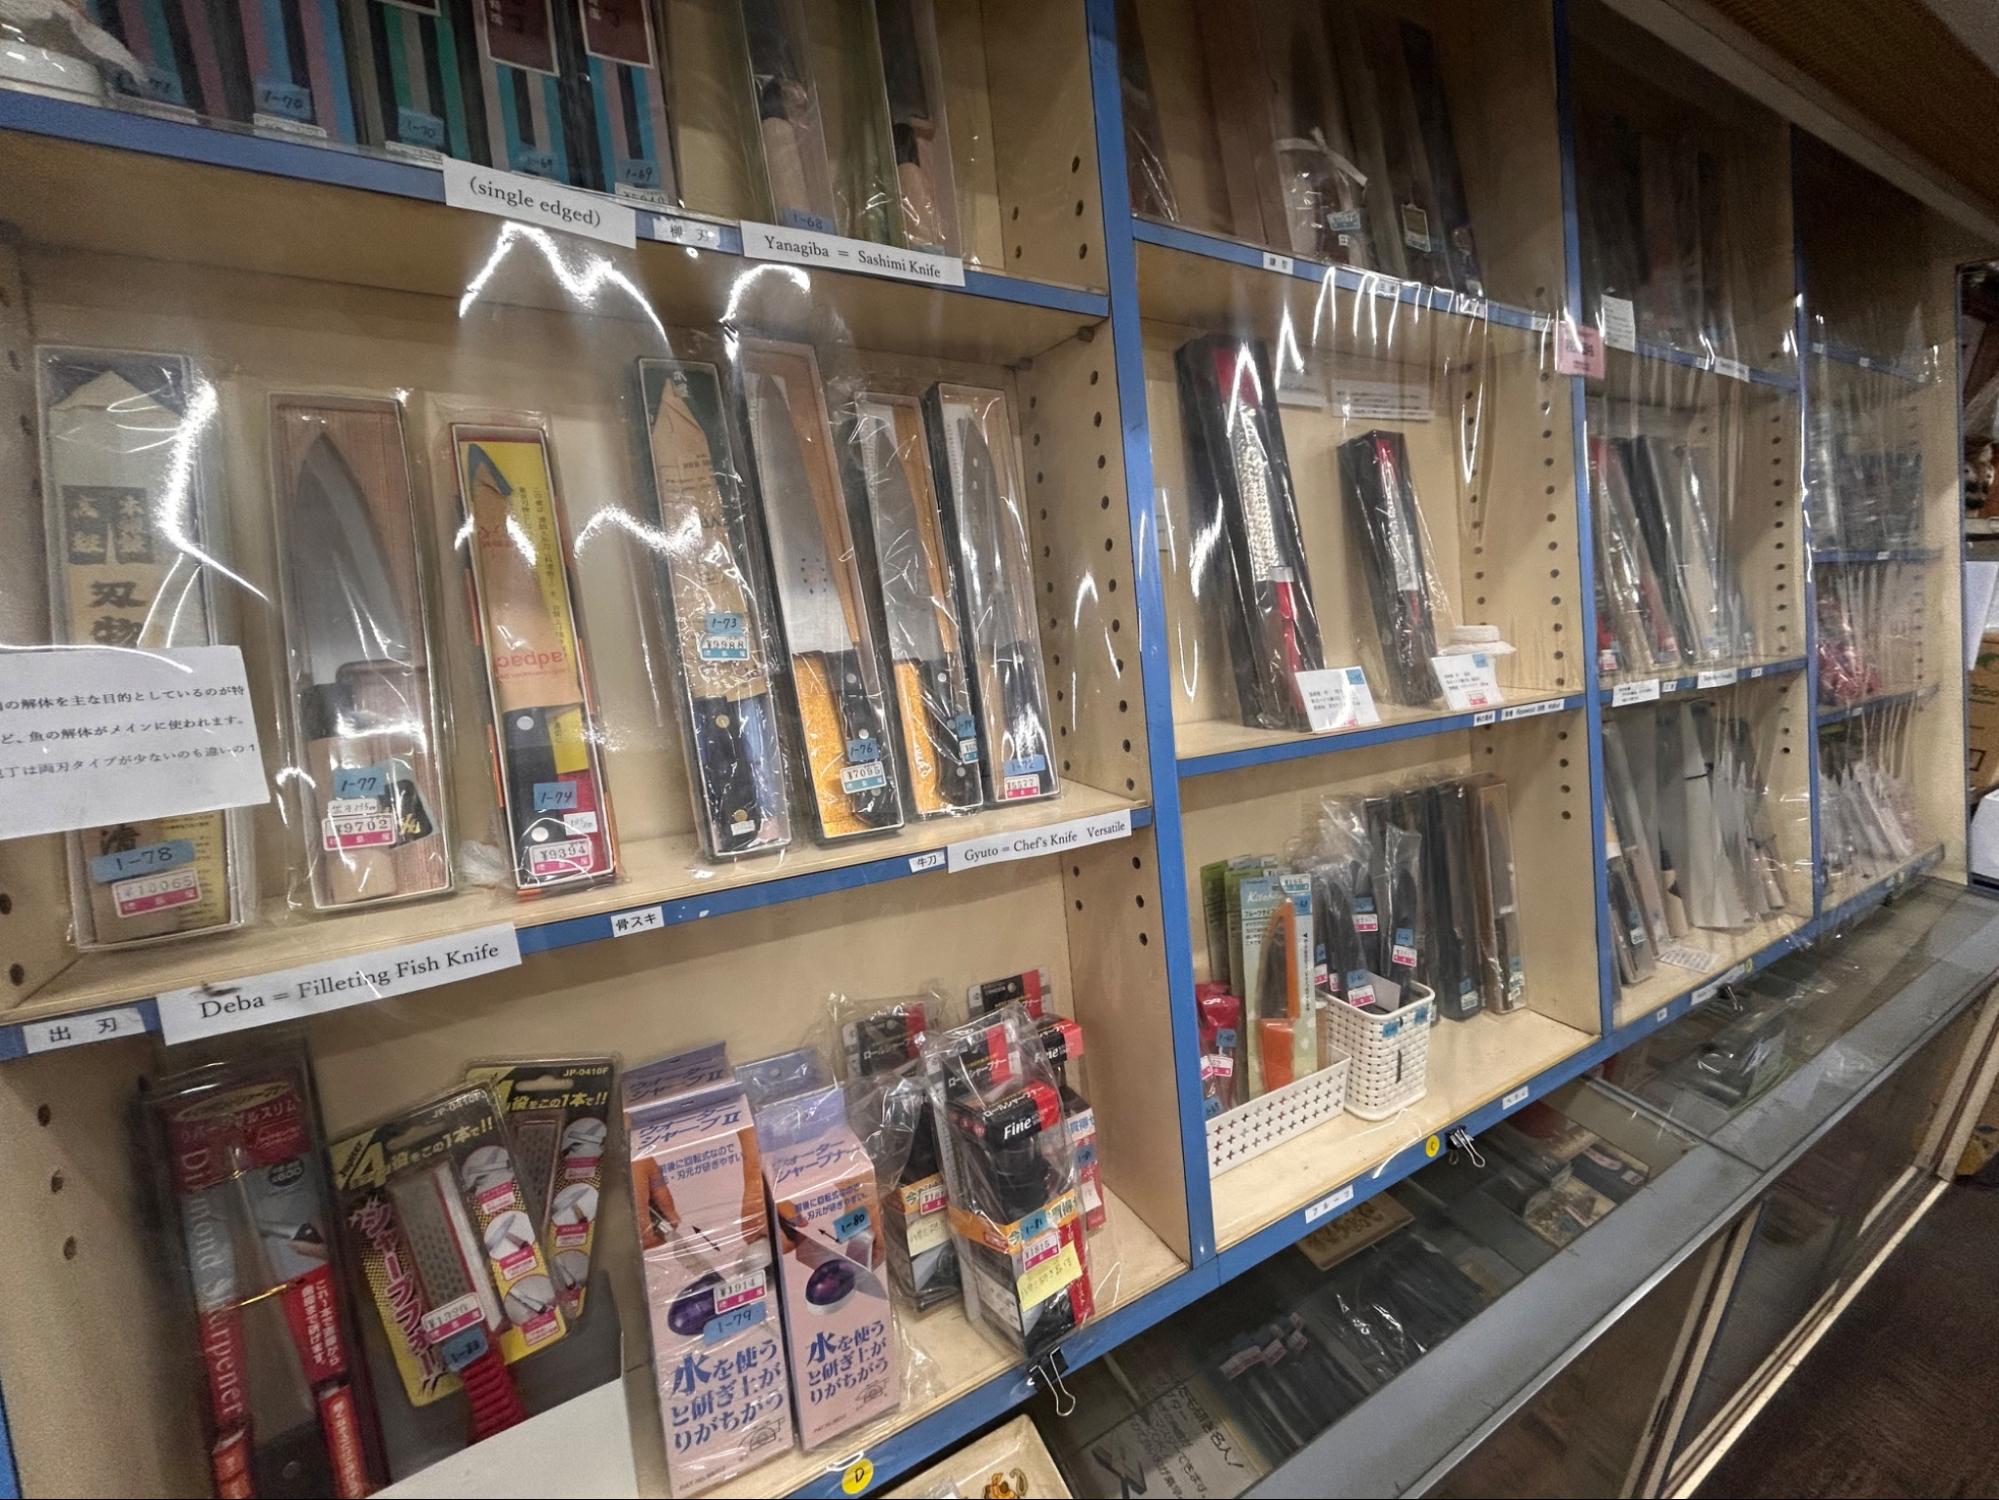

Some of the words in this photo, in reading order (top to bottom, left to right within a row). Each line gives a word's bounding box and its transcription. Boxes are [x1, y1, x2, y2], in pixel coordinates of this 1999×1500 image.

[625, 165, 654, 181] 1-69
[470, 175, 534, 208] (single
[540, 199, 601, 228] edged)
[793, 213, 824, 230] 1-68
[764, 235, 830, 258] Yanagiba
[858, 249, 906, 272] Sashimi
[908, 259, 941, 279] Knife
[712, 617, 738, 629] 1-73
[850, 743, 873, 755] 1-76
[341, 776, 378, 792] 1-77
[847, 765, 882, 780] ¥7095
[540, 790, 573, 805] 1-74
[964, 846, 999, 863] Gyuto
[1013, 835, 1048, 852] Chef's
[1050, 831, 1078, 847] Knife
[1086, 821, 1126, 839] Versatile
[116, 846, 173, 872] 1-78
[917, 855, 938, 868] 牛刀
[616, 913, 657, 932] 骨スキ
[200, 993, 266, 1020] Deba
[298, 964, 391, 1000] Filleting
[396, 956, 440, 980] Fish
[446, 943, 500, 968] Knife
[49, 1016, 118, 1043] 出刃
[1003, 1117, 1033, 1141] Fine
[718, 1310, 752, 1332] 1-79
[806, 1319, 885, 1367] 水を使う
[671, 1338, 778, 1396] 水を使う
[808, 1337, 887, 1387] と研ぎ上が
[810, 1356, 889, 1406] りがちがう
[672, 1361, 781, 1427] と研ぎ上が
[674, 1391, 784, 1452] りがちがう
[855, 1467, 865, 1484] D
